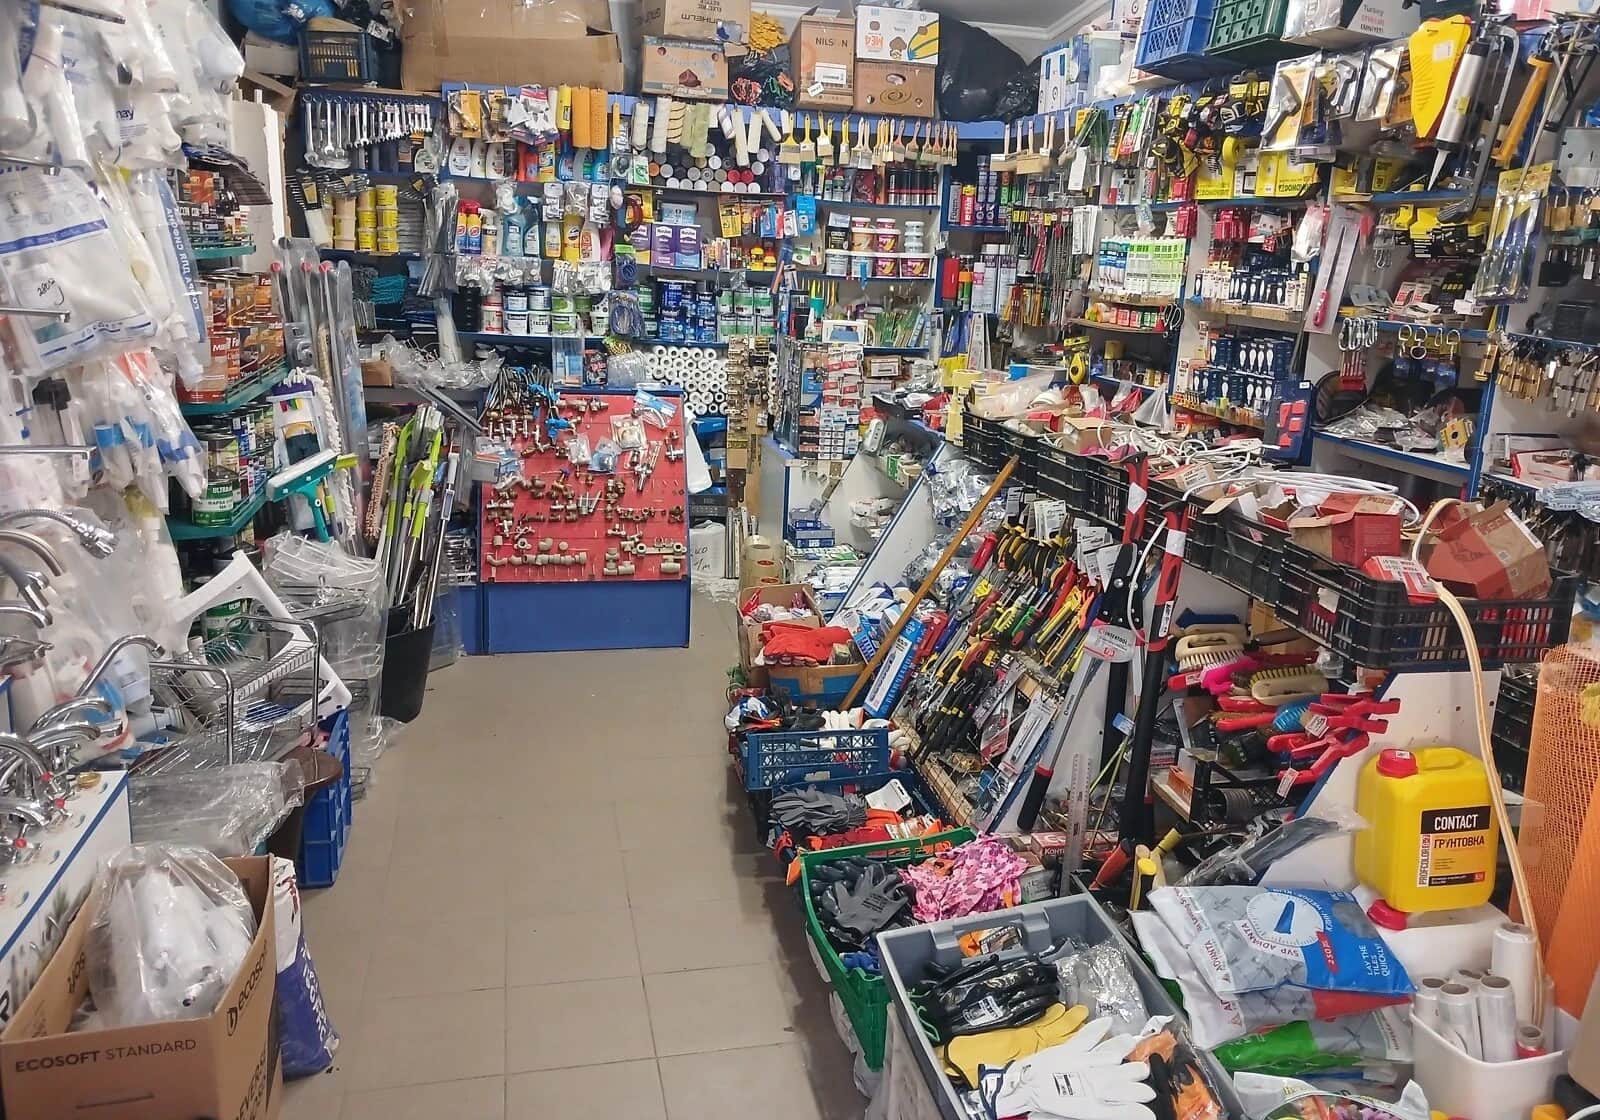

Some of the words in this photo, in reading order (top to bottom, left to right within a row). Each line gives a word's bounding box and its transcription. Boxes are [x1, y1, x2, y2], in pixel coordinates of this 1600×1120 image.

[816, 37, 848, 48] NILSN
[1434, 814, 1478, 831] CONTACT
[1434, 836, 1484, 849] ГРУНТОВКА
[1242, 923, 1277, 951] ADVANTA
[1280, 948, 1299, 958] SVP
[1358, 944, 1368, 960] THE
[1364, 962, 1373, 976] LAY
[1370, 955, 1380, 976] TILES
[15, 1049, 99, 1073] ECOSOFT
[105, 1039, 197, 1060] STANDARD
